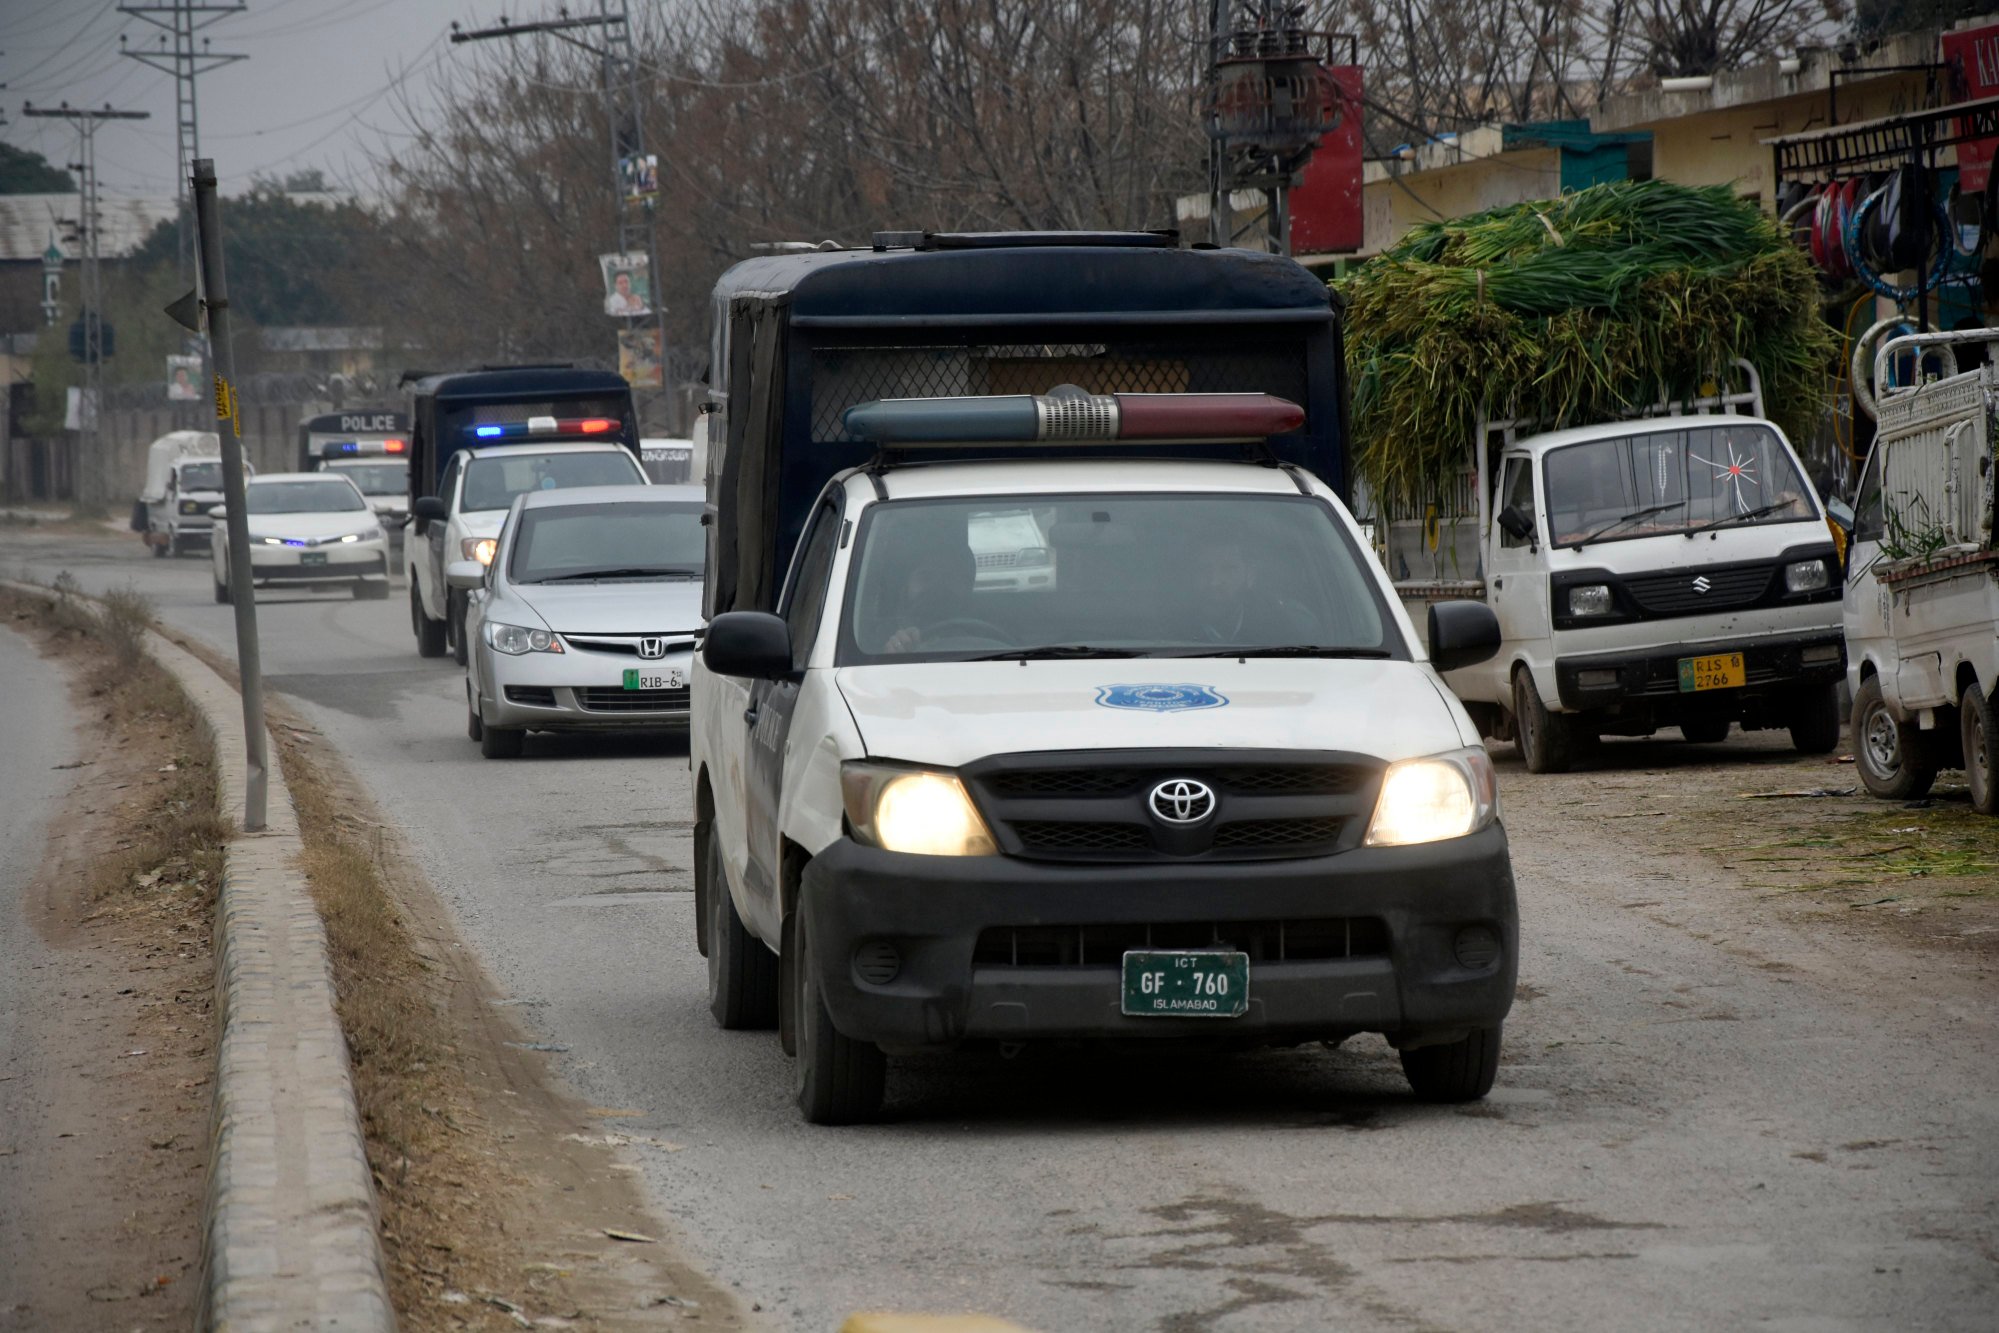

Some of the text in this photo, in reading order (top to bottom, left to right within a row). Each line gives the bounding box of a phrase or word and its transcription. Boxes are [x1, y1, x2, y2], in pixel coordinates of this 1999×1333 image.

[341, 415, 395, 431] POLICE
[1697, 659, 1722, 672] RIS
[1696, 673, 1728, 687] 2766
[1175, 957, 1197, 968] ICT
[1141, 971, 1228, 995] GF 760
[1153, 999, 1217, 1010] ISLAMABAD
